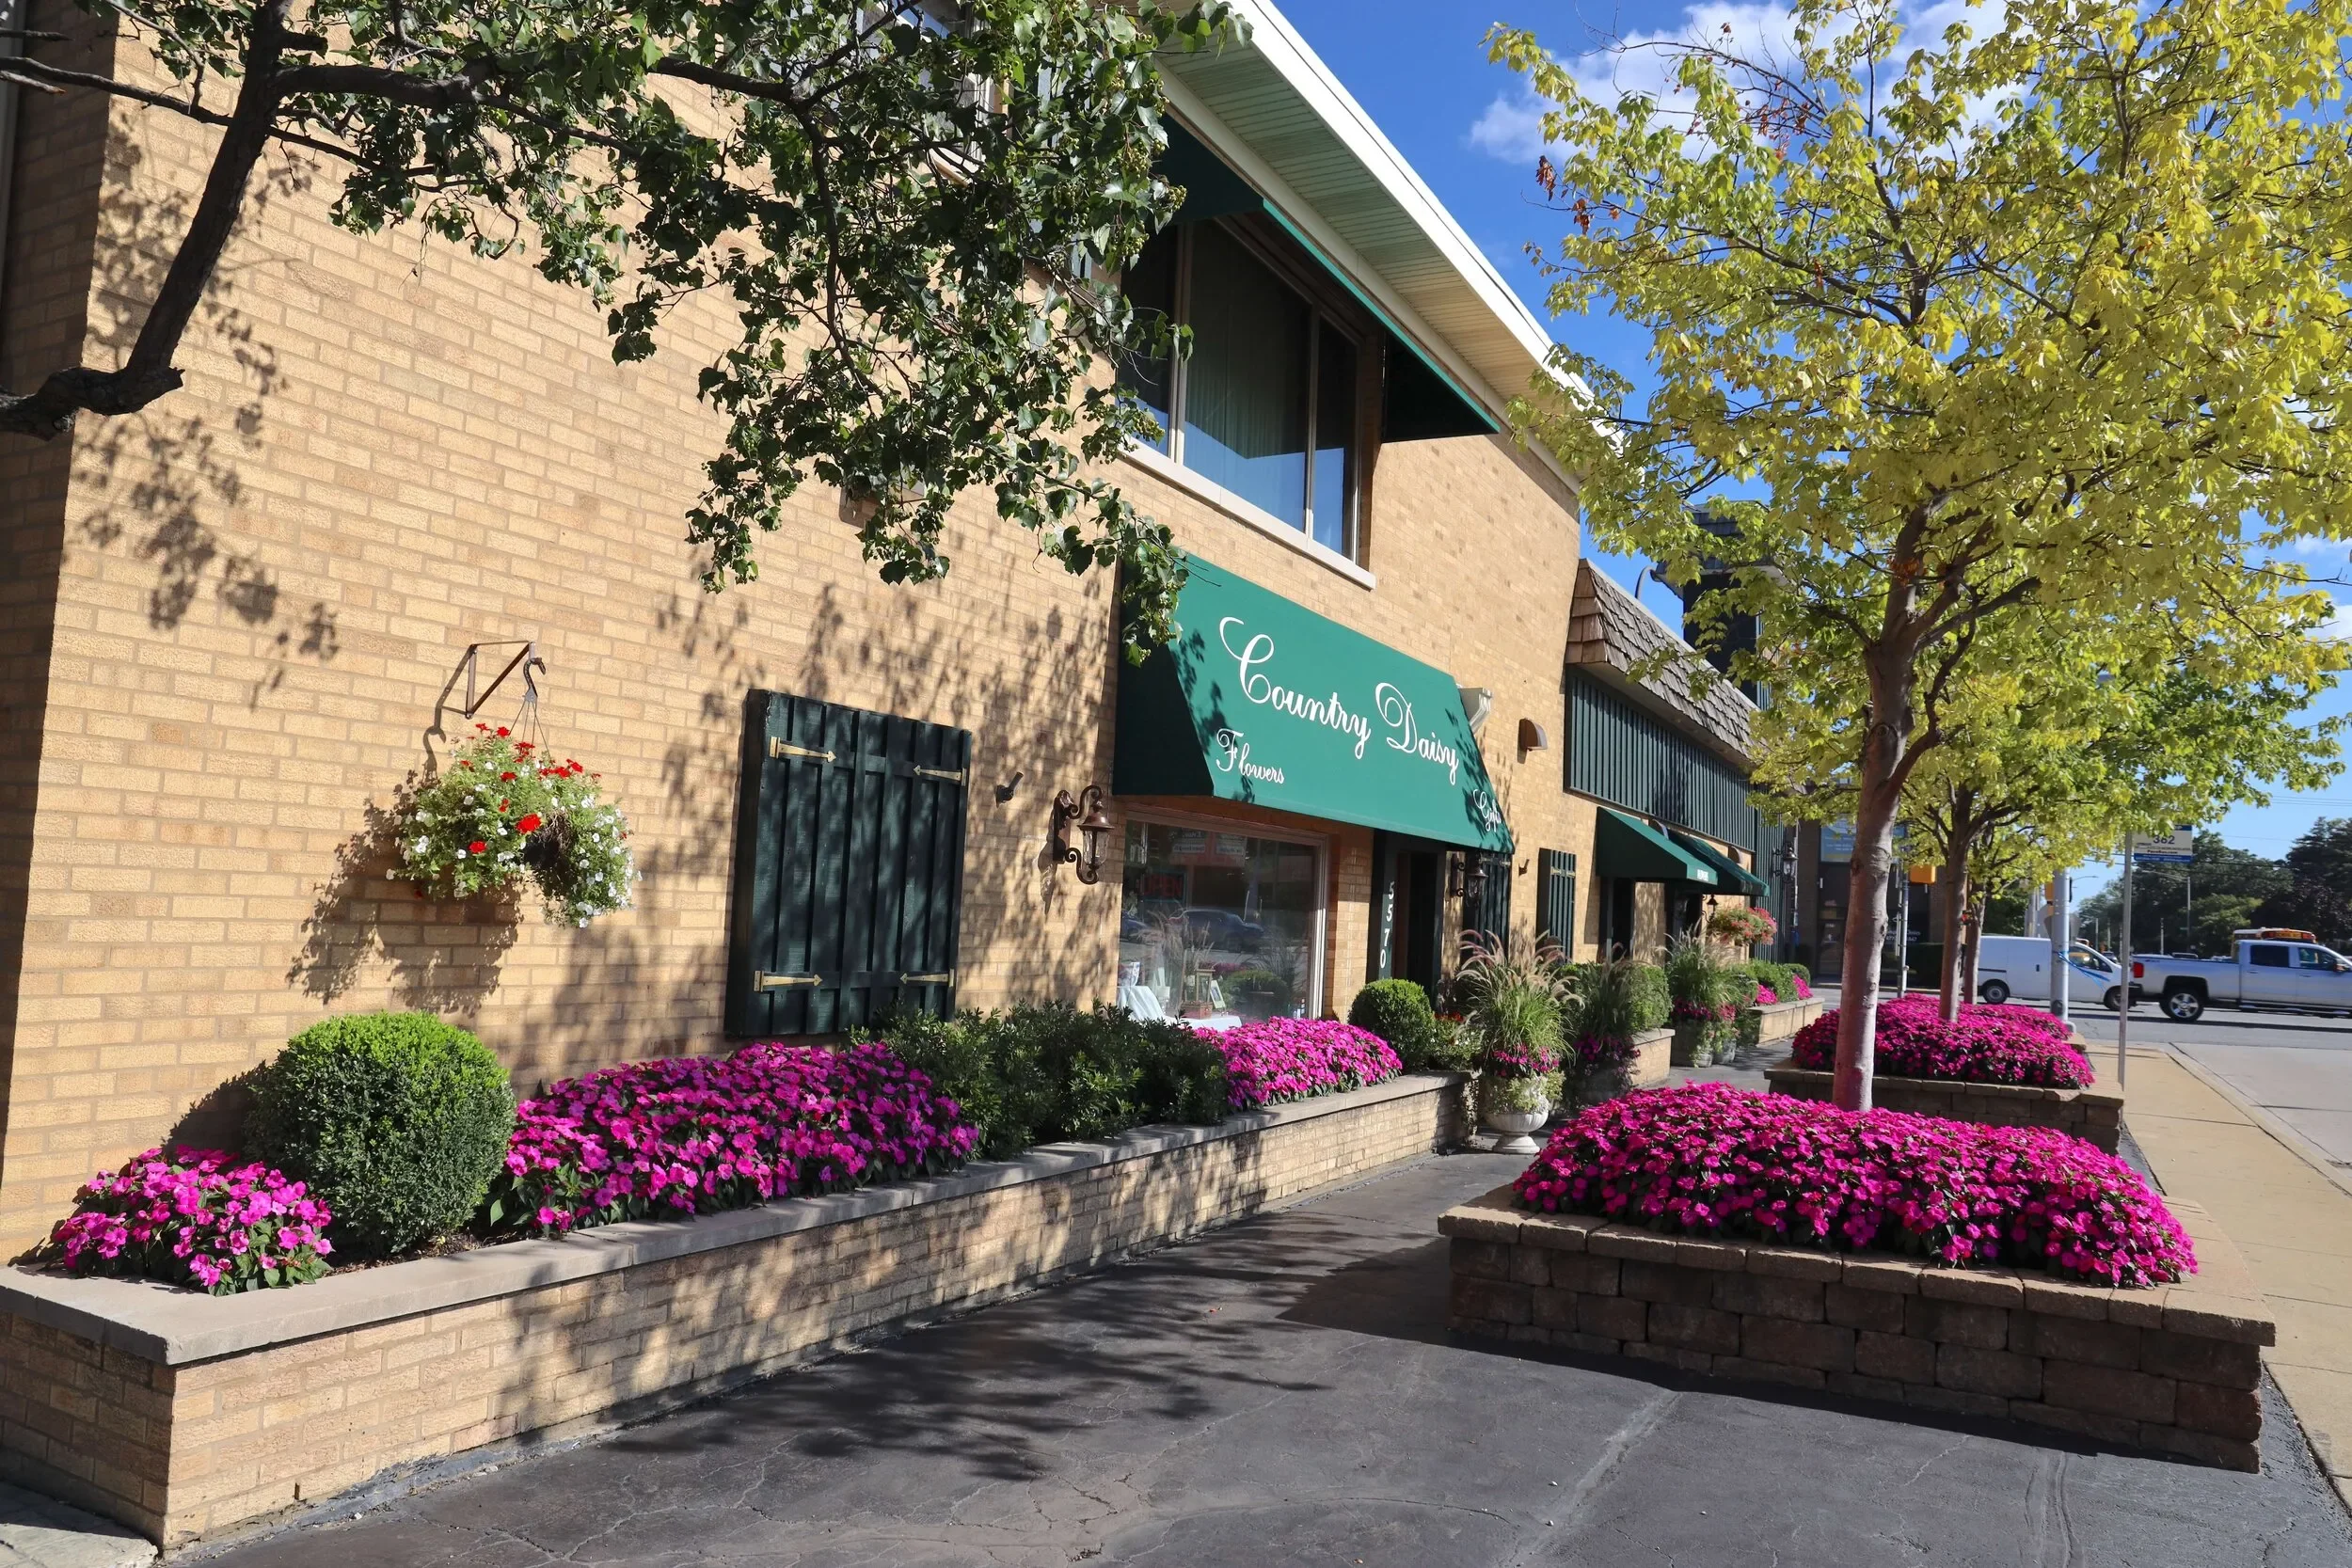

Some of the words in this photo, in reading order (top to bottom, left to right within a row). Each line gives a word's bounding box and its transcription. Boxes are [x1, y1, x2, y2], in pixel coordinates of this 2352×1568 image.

[1219, 617, 1371, 759] Country
[1375, 683, 1459, 785] Daisy
[1216, 729, 1284, 784] Flowers
[1473, 789, 1502, 832] Gifts
[1379, 881, 1394, 969] 5570
